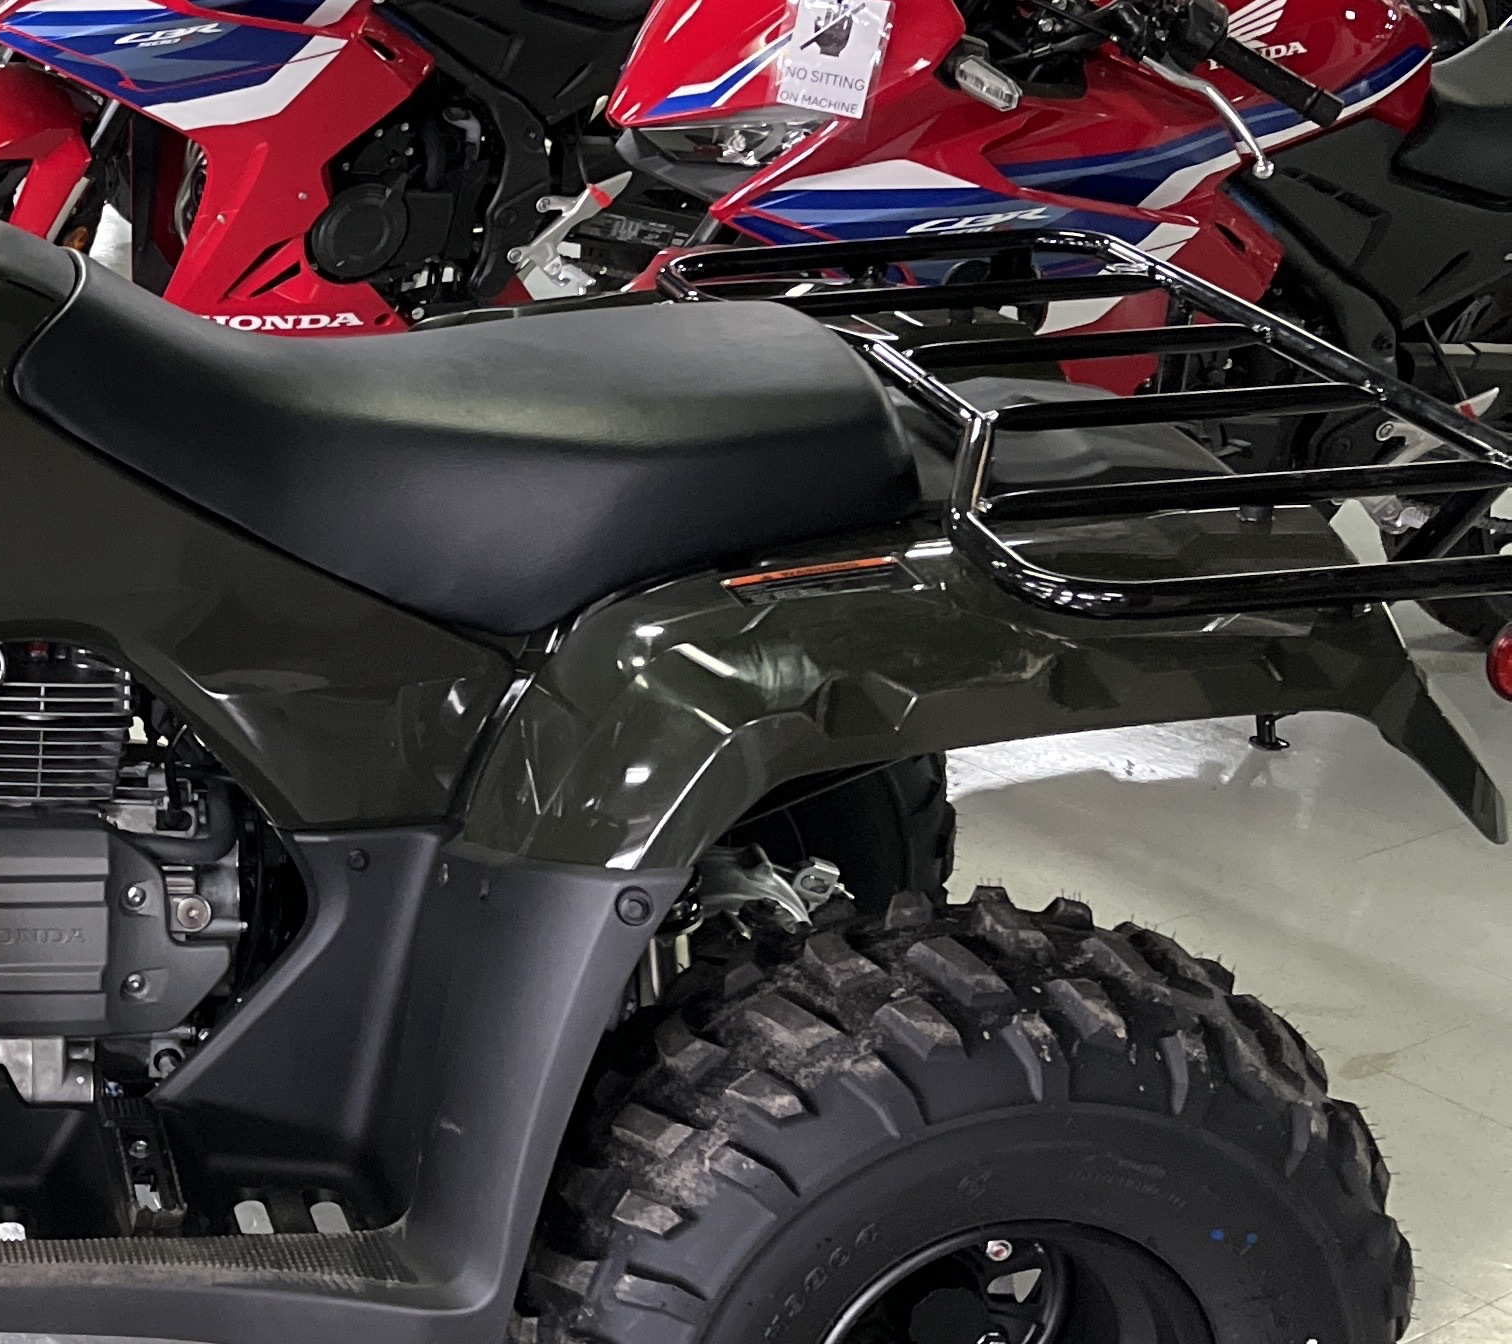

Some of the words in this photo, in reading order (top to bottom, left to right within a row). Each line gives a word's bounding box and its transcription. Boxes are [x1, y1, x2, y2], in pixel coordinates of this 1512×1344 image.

[785, 66, 808, 81] NO
[810, 70, 866, 92] SITTING
[780, 90, 799, 103] ON
[801, 94, 859, 115] MACHINE
